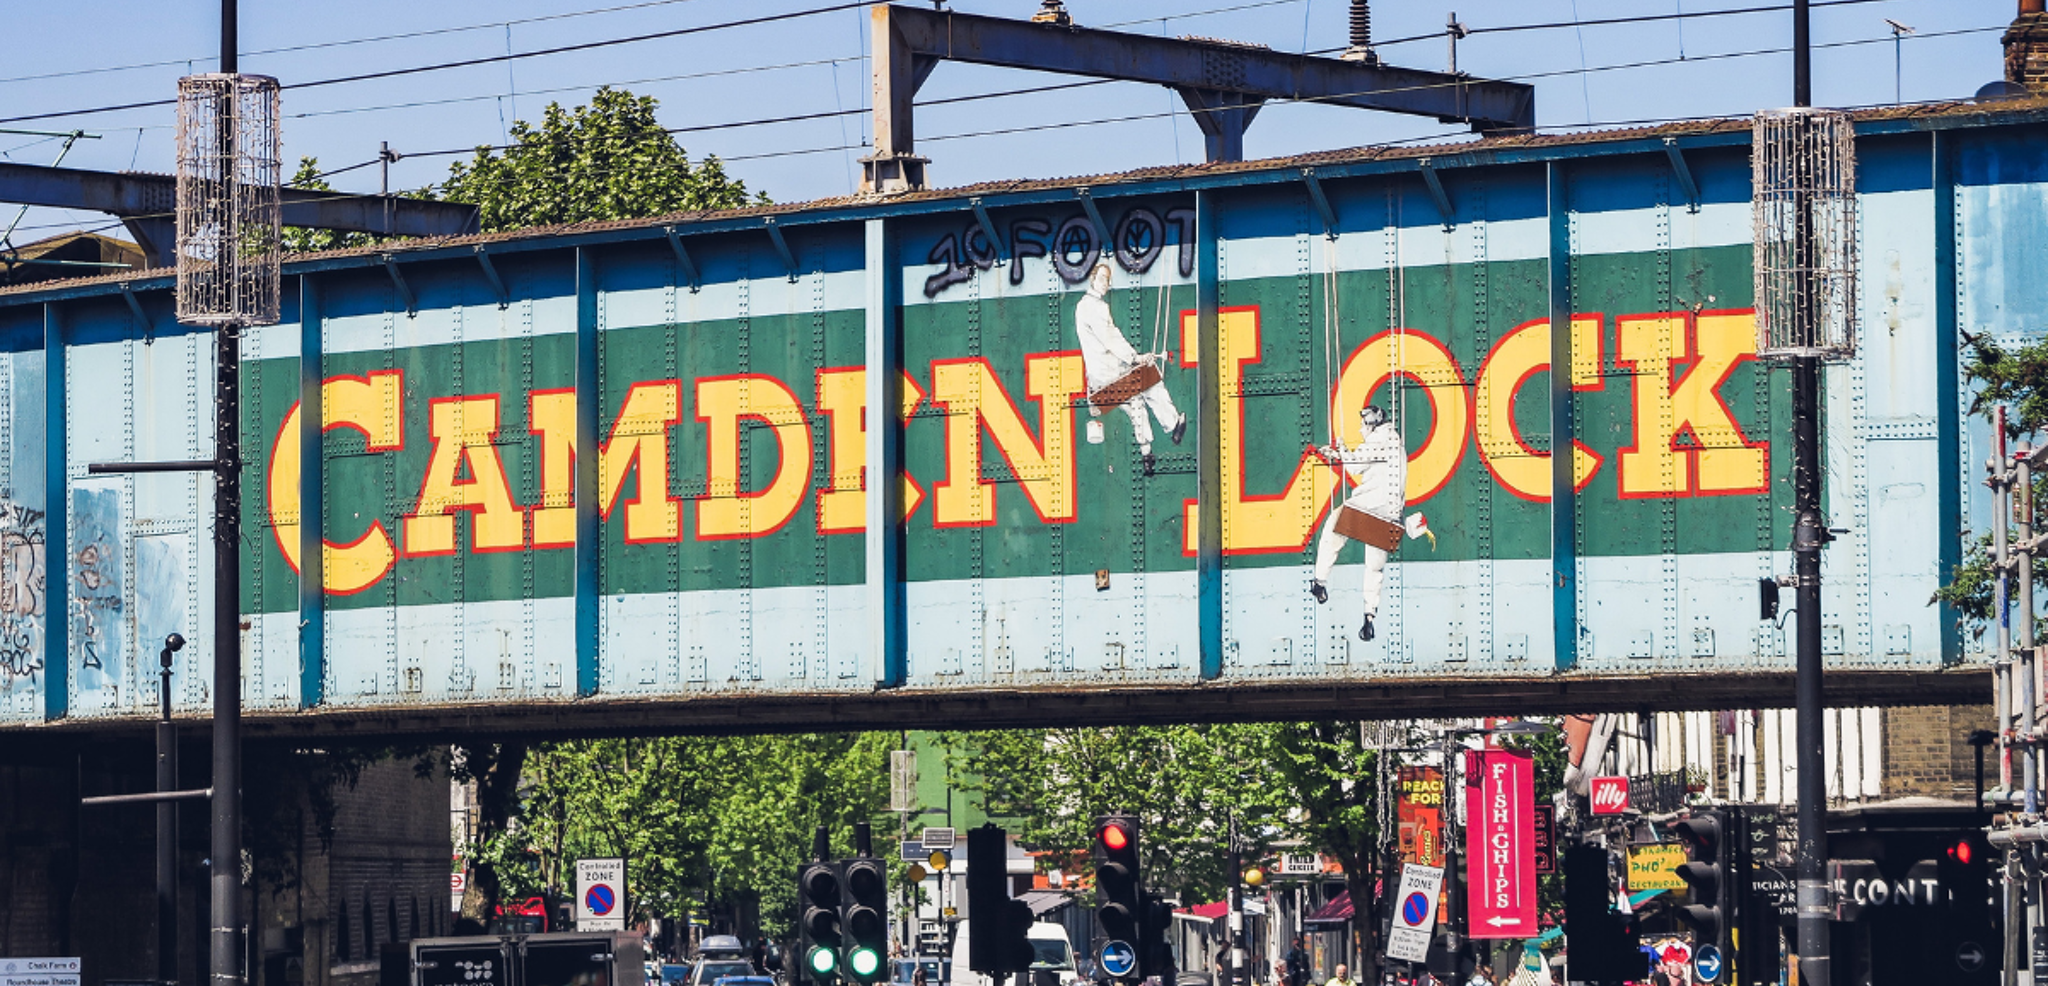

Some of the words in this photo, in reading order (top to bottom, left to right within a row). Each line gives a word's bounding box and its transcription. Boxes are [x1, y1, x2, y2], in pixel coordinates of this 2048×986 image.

[267, 350, 1086, 596] CAMDEN
[1180, 305, 1771, 557] LOCK
[1411, 793, 1441, 805] FOR
[1492, 763, 1509, 823] FISH
[1595, 783, 1627, 810] illy
[580, 862, 620, 870] Controlled
[1406, 866, 1441, 879] Controlled
[1491, 833, 1509, 908] CHIPS
[585, 871, 614, 881] ZONE
[1407, 877, 1433, 890] ZONE
